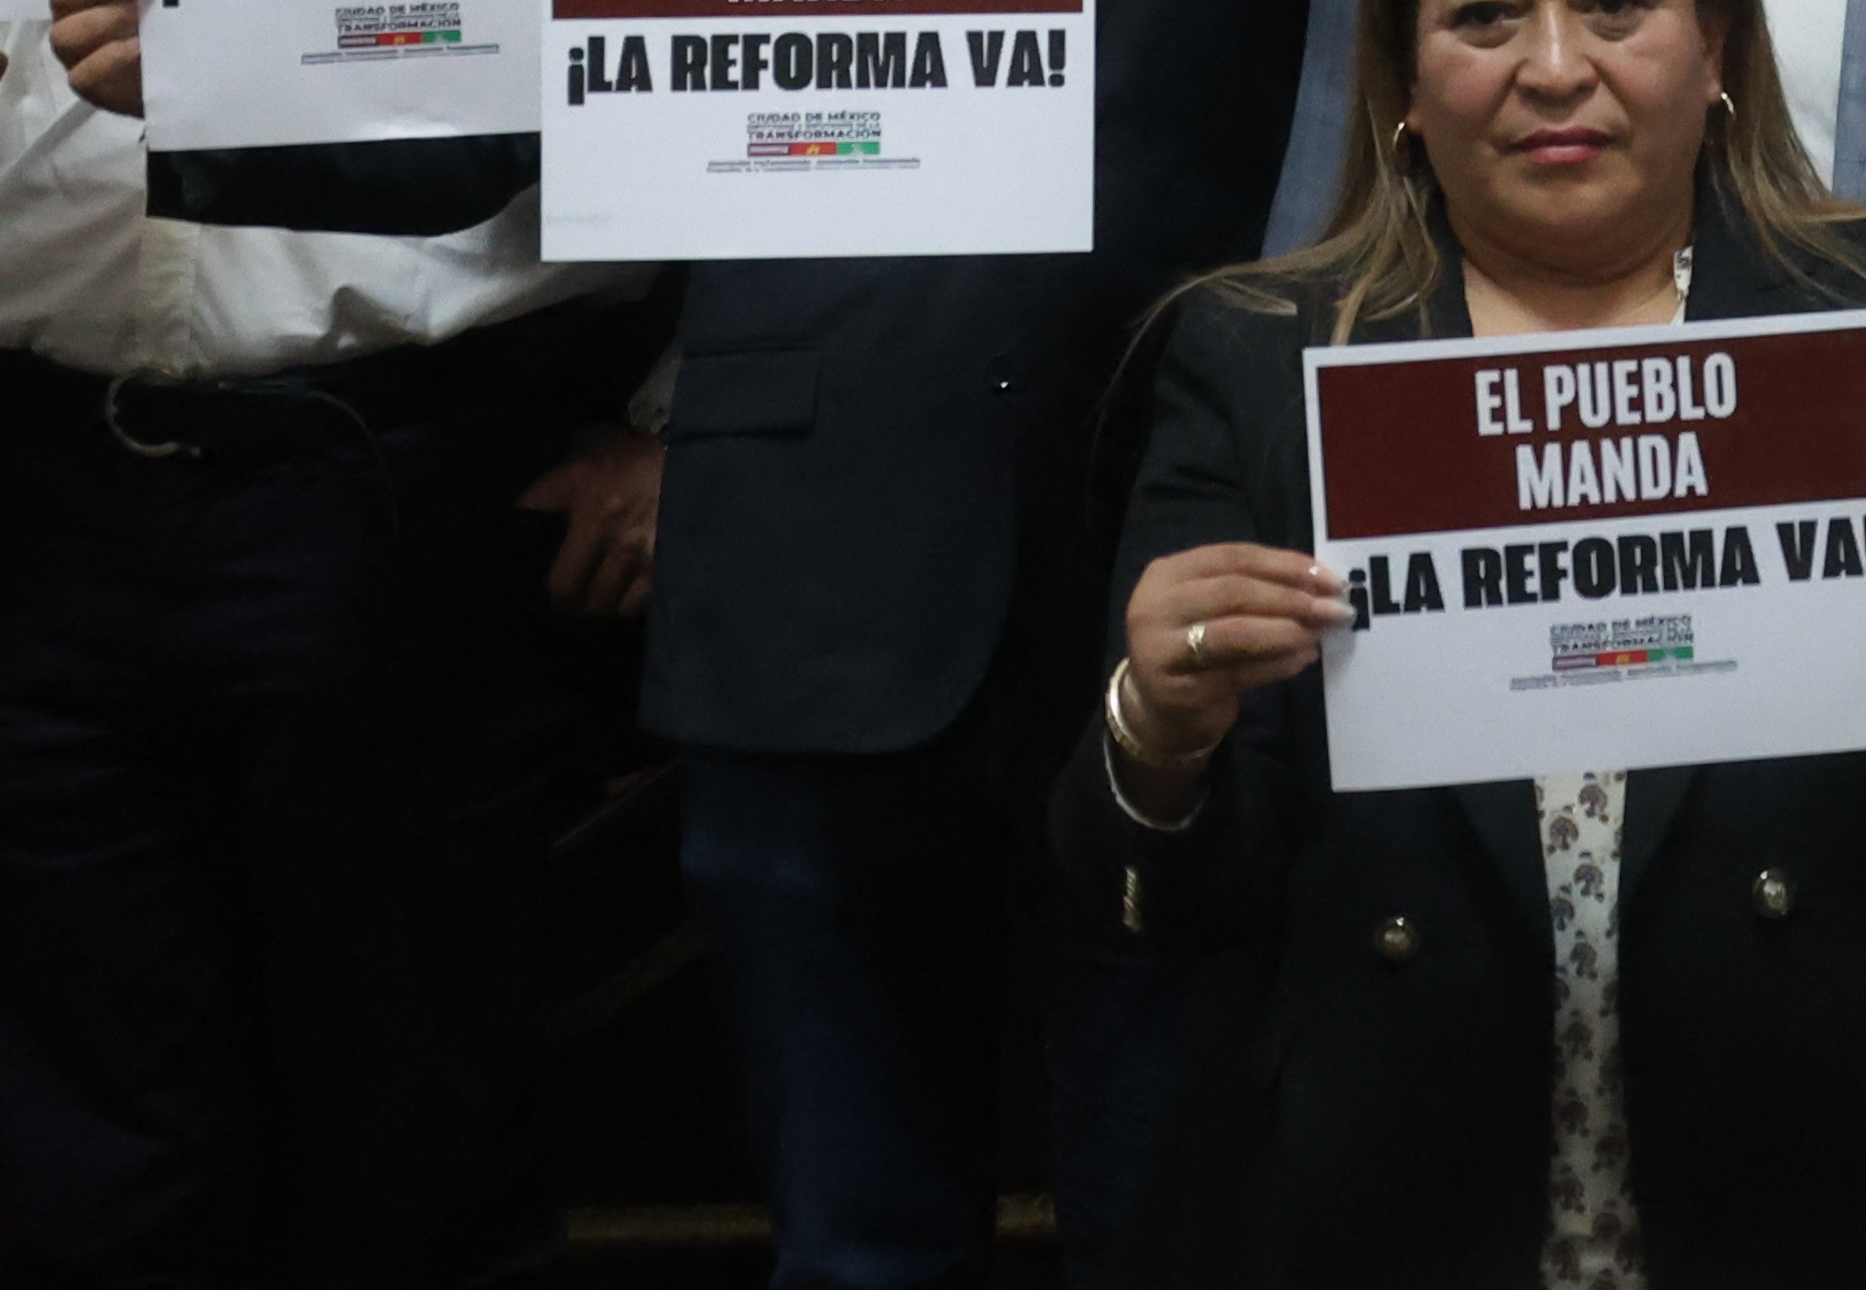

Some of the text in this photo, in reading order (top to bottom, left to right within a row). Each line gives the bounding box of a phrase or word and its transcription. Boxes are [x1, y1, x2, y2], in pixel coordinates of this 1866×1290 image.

[568, 30, 1065, 105] ¡LA REFORMA VA!
[1475, 353, 1736, 435] EL PUEBLO
[1516, 432, 1707, 509] MANDA
[1348, 552, 1444, 631] ¡LA
[1461, 526, 1760, 608] REFORMA
